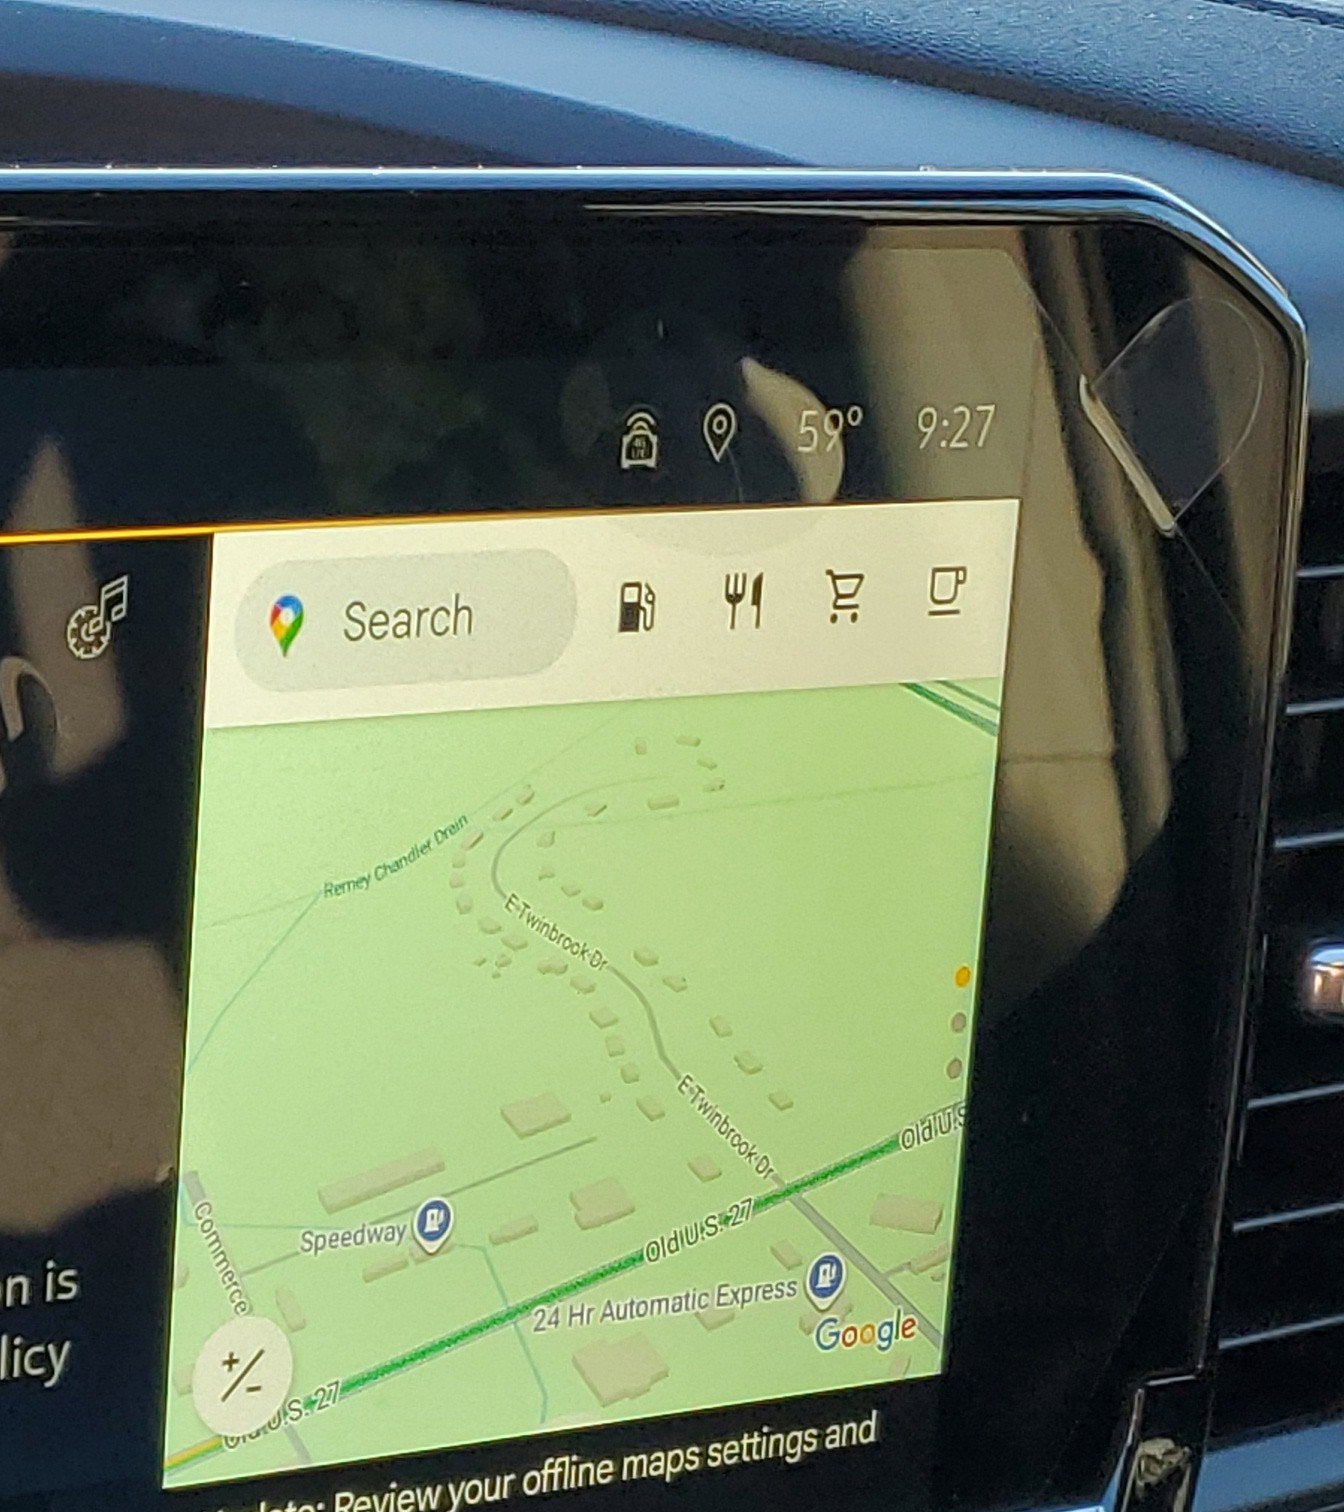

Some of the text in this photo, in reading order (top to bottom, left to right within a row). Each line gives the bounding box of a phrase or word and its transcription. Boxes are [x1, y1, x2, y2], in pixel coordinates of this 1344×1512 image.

[917, 404, 997, 449] 9:27
[343, 593, 474, 642] Search
[374, 839, 433, 881] Chandler
[433, 814, 469, 846] Drain
[518, 901, 589, 961] Twinbrook
[589, 949, 609, 971] Dr
[688, 1084, 760, 1166] Twinbrook
[755, 1153, 775, 1180] Dr
[194, 1201, 247, 1316] Commerce
[299, 1223, 407, 1256] Speedway
[644, 1230, 680, 1263] Old
[728, 1199, 754, 1227] 27
[44, 1259, 79, 1303] is
[532, 1278, 799, 1333] 24 Hr Automatic Express
[814, 1306, 917, 1352] Google
[314, 1379, 340, 1411] 27
[522, 1454, 614, 1497] offline
[621, 1445, 701, 1483] maps
[707, 1425, 819, 1467] settings
[824, 1409, 880, 1450] and
